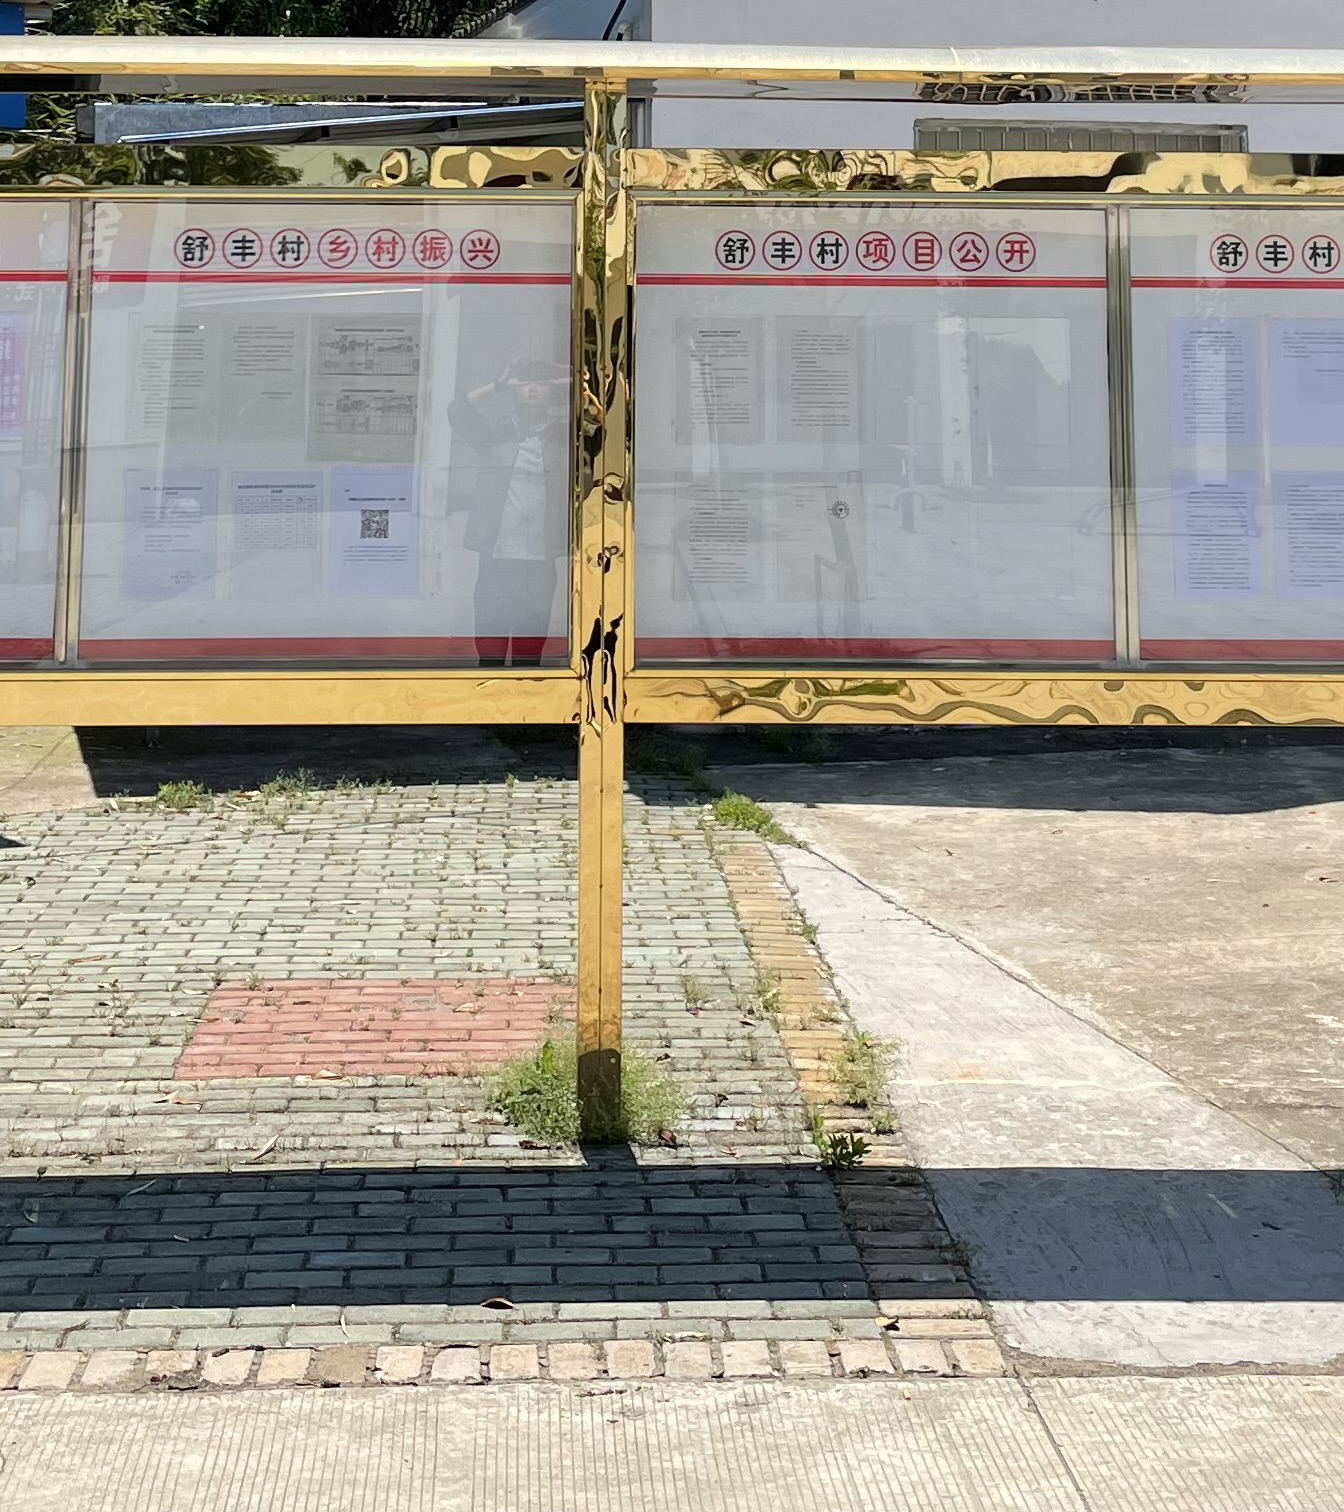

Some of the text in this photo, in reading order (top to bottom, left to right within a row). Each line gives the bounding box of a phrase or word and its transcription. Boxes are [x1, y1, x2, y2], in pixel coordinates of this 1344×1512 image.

[180, 233, 496, 264] 舒丰村乡村振兴
[721, 235, 1032, 266] 舒丰村项目公开
